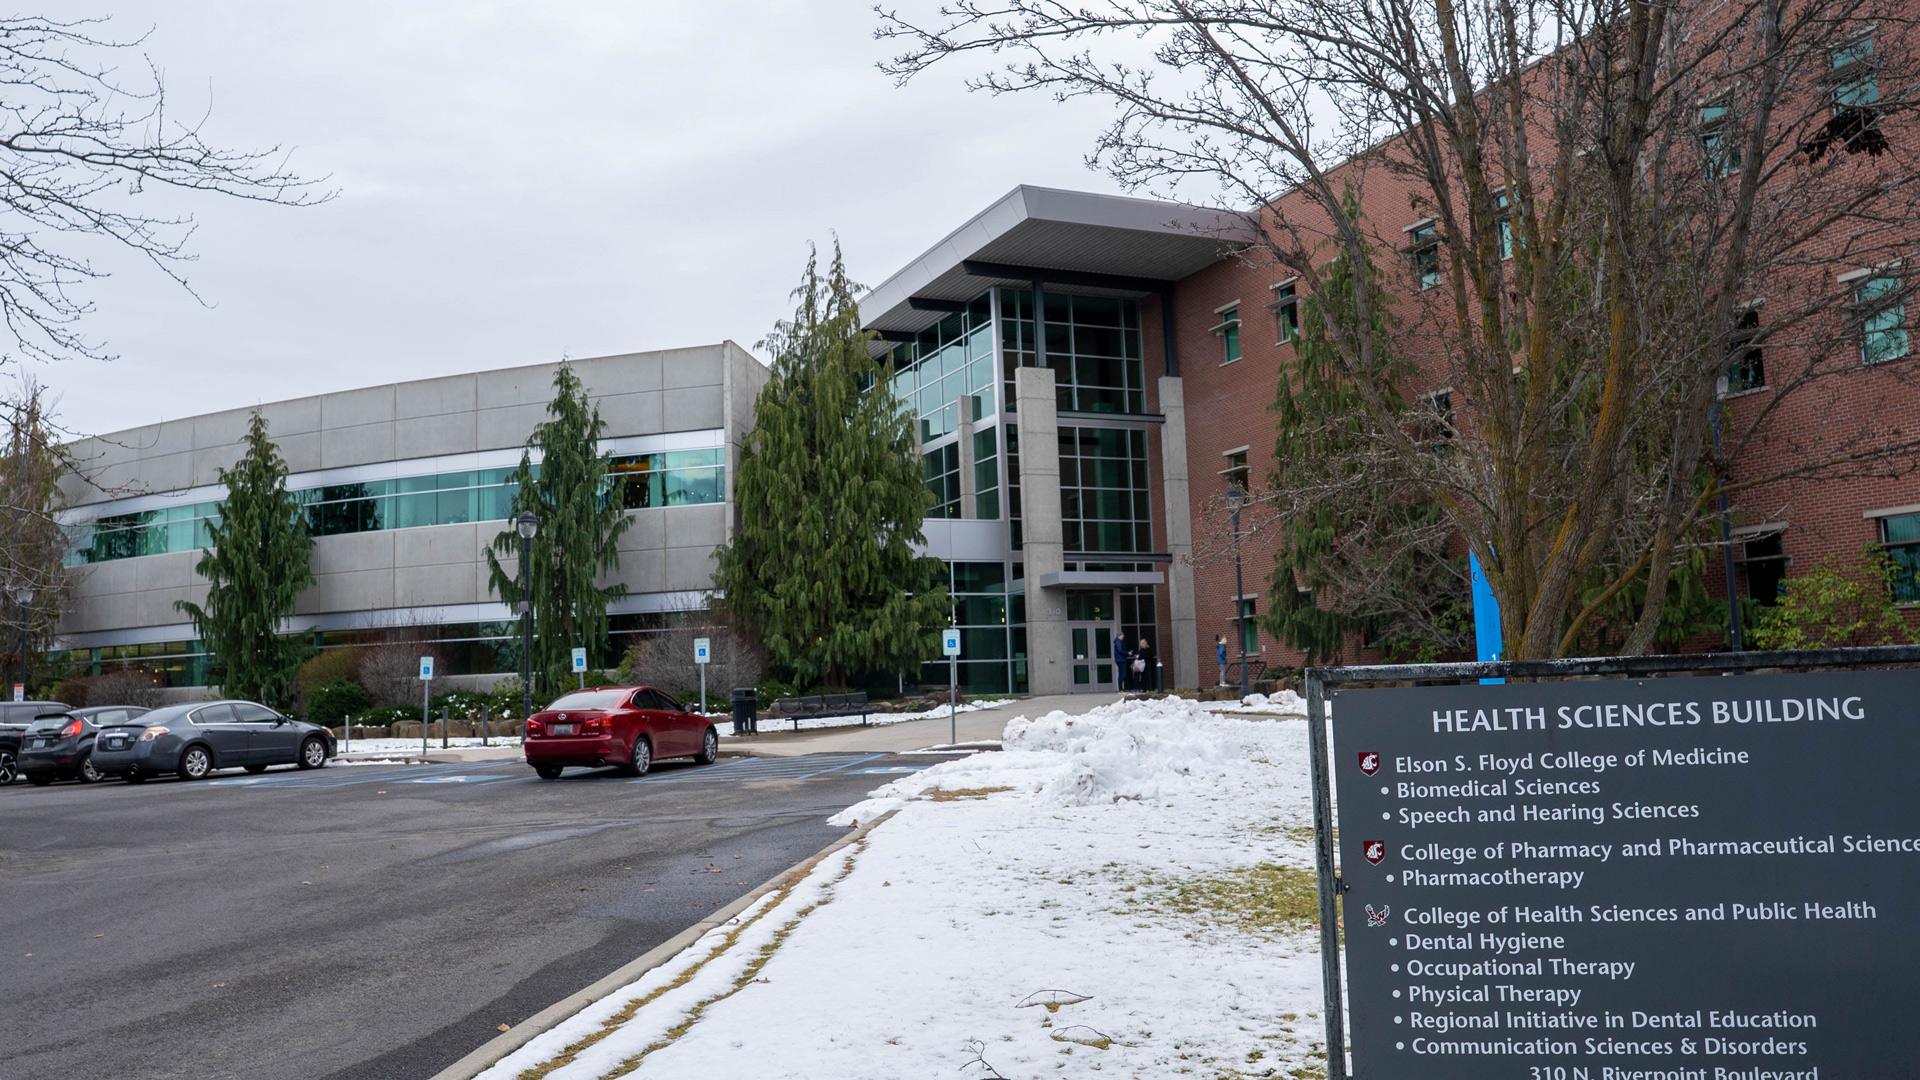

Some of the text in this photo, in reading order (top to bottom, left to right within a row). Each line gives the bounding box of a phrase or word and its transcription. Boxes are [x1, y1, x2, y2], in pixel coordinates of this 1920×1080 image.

[1046, 607, 1062, 616] 310
[1432, 696, 1865, 733] HEALTH SCIENCES BUILDING
[1395, 747, 1749, 776] Elson S. Floyd College of Medicine
[1397, 778, 1601, 799] Biomedical Sciences
[1398, 801, 1700, 829] Speech and Hearing Sciences
[1400, 843, 1477, 865] College
[1483, 841, 1505, 860] of
[1511, 841, 1613, 863] Pharmacy
[1621, 838, 1662, 857] and
[1668, 834, 1835, 856] Pharmaceutical
[1402, 867, 1585, 890] Pharmacotherapy
[1403, 900, 1877, 929] College of Health Sciences and Public Health
[1405, 931, 1565, 955] Dental Hygiene
[1406, 957, 1636, 981] Occupational Therapy
[1408, 984, 1582, 1008] Physical Therapy
[1410, 1010, 1817, 1034] Regional Initiative in Dental Education
[1412, 1036, 1808, 1055] Communication Sciences & Disorders
